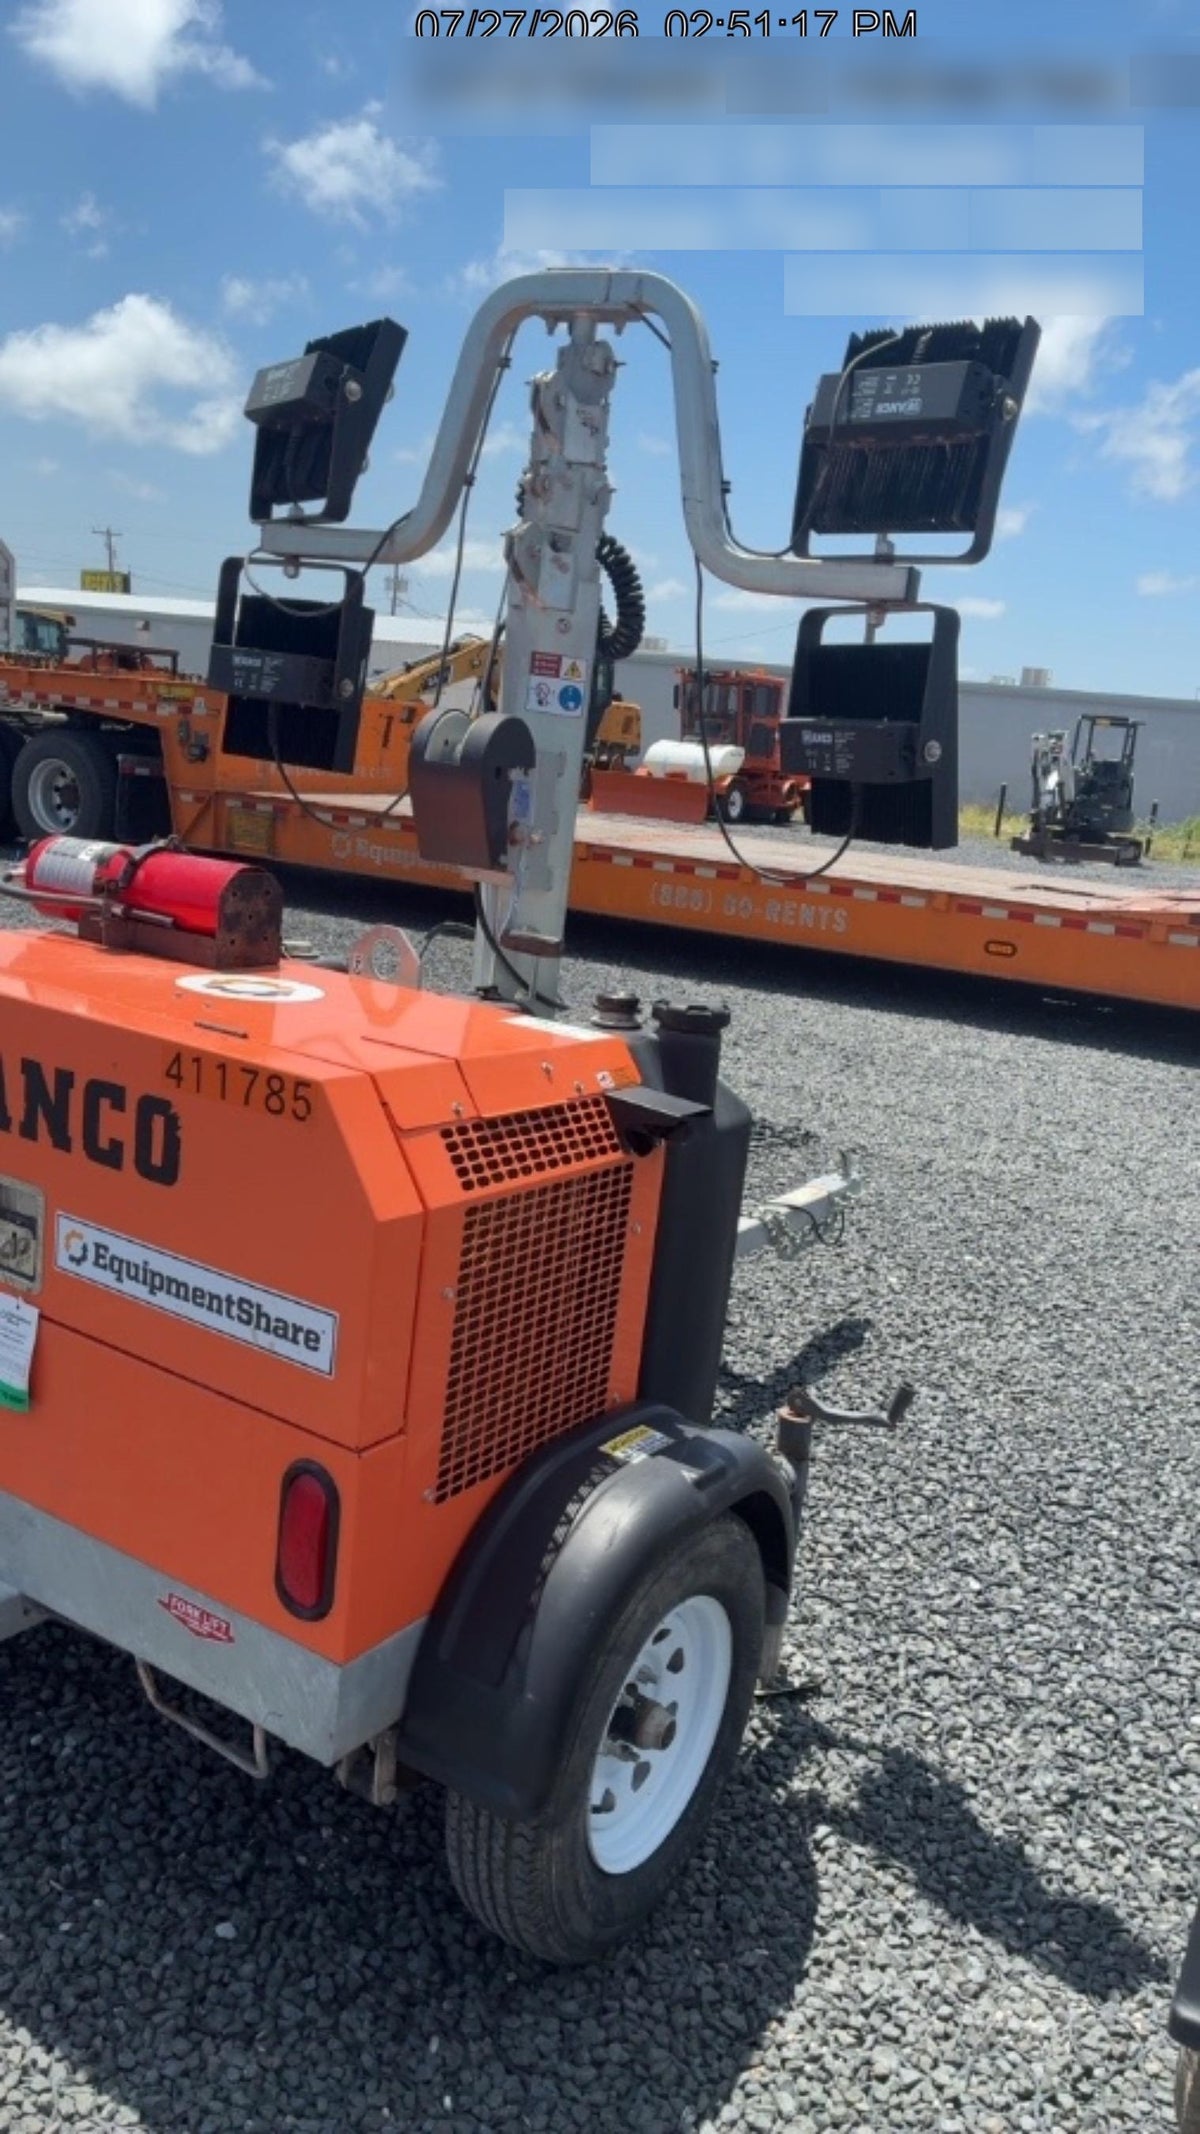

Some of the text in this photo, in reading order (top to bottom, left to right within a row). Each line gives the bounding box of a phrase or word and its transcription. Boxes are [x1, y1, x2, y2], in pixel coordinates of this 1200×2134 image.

[0, 1054, 182, 1187] NCO
[165, 1052, 312, 1122] 411785
[92, 1241, 321, 1353] EquipmentShare
